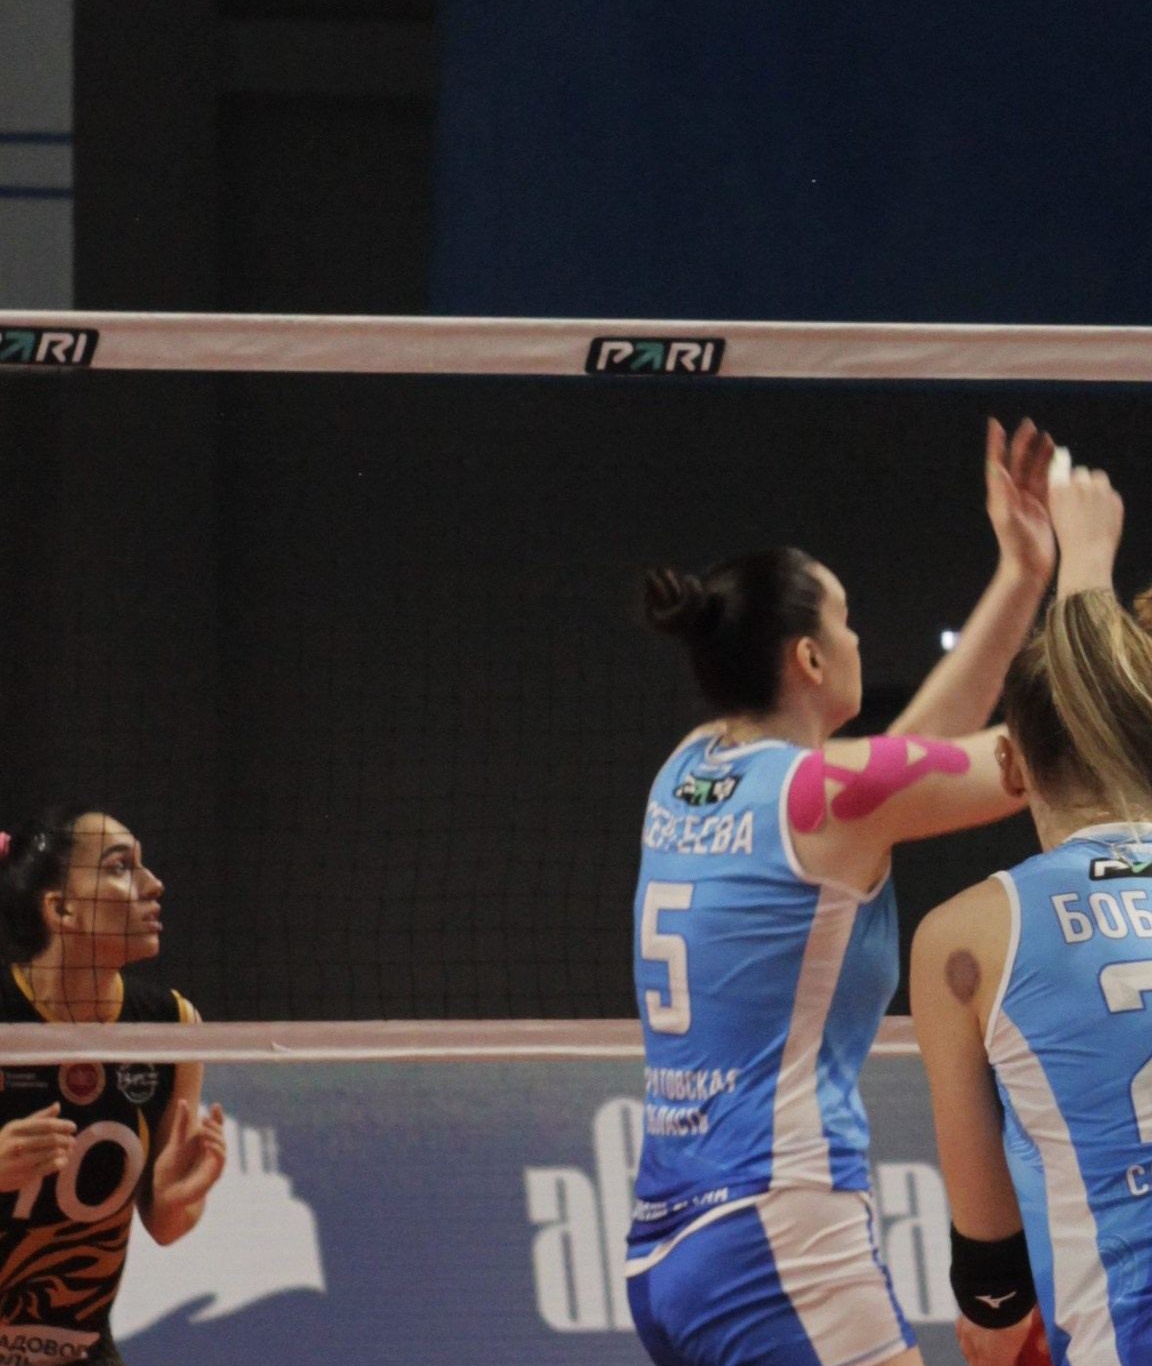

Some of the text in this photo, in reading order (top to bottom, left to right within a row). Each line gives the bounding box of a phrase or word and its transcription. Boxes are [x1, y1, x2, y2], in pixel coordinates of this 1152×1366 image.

[0, 331, 87, 363] ARI
[597, 341, 714, 371] PARI
[641, 881, 694, 1034] 5
